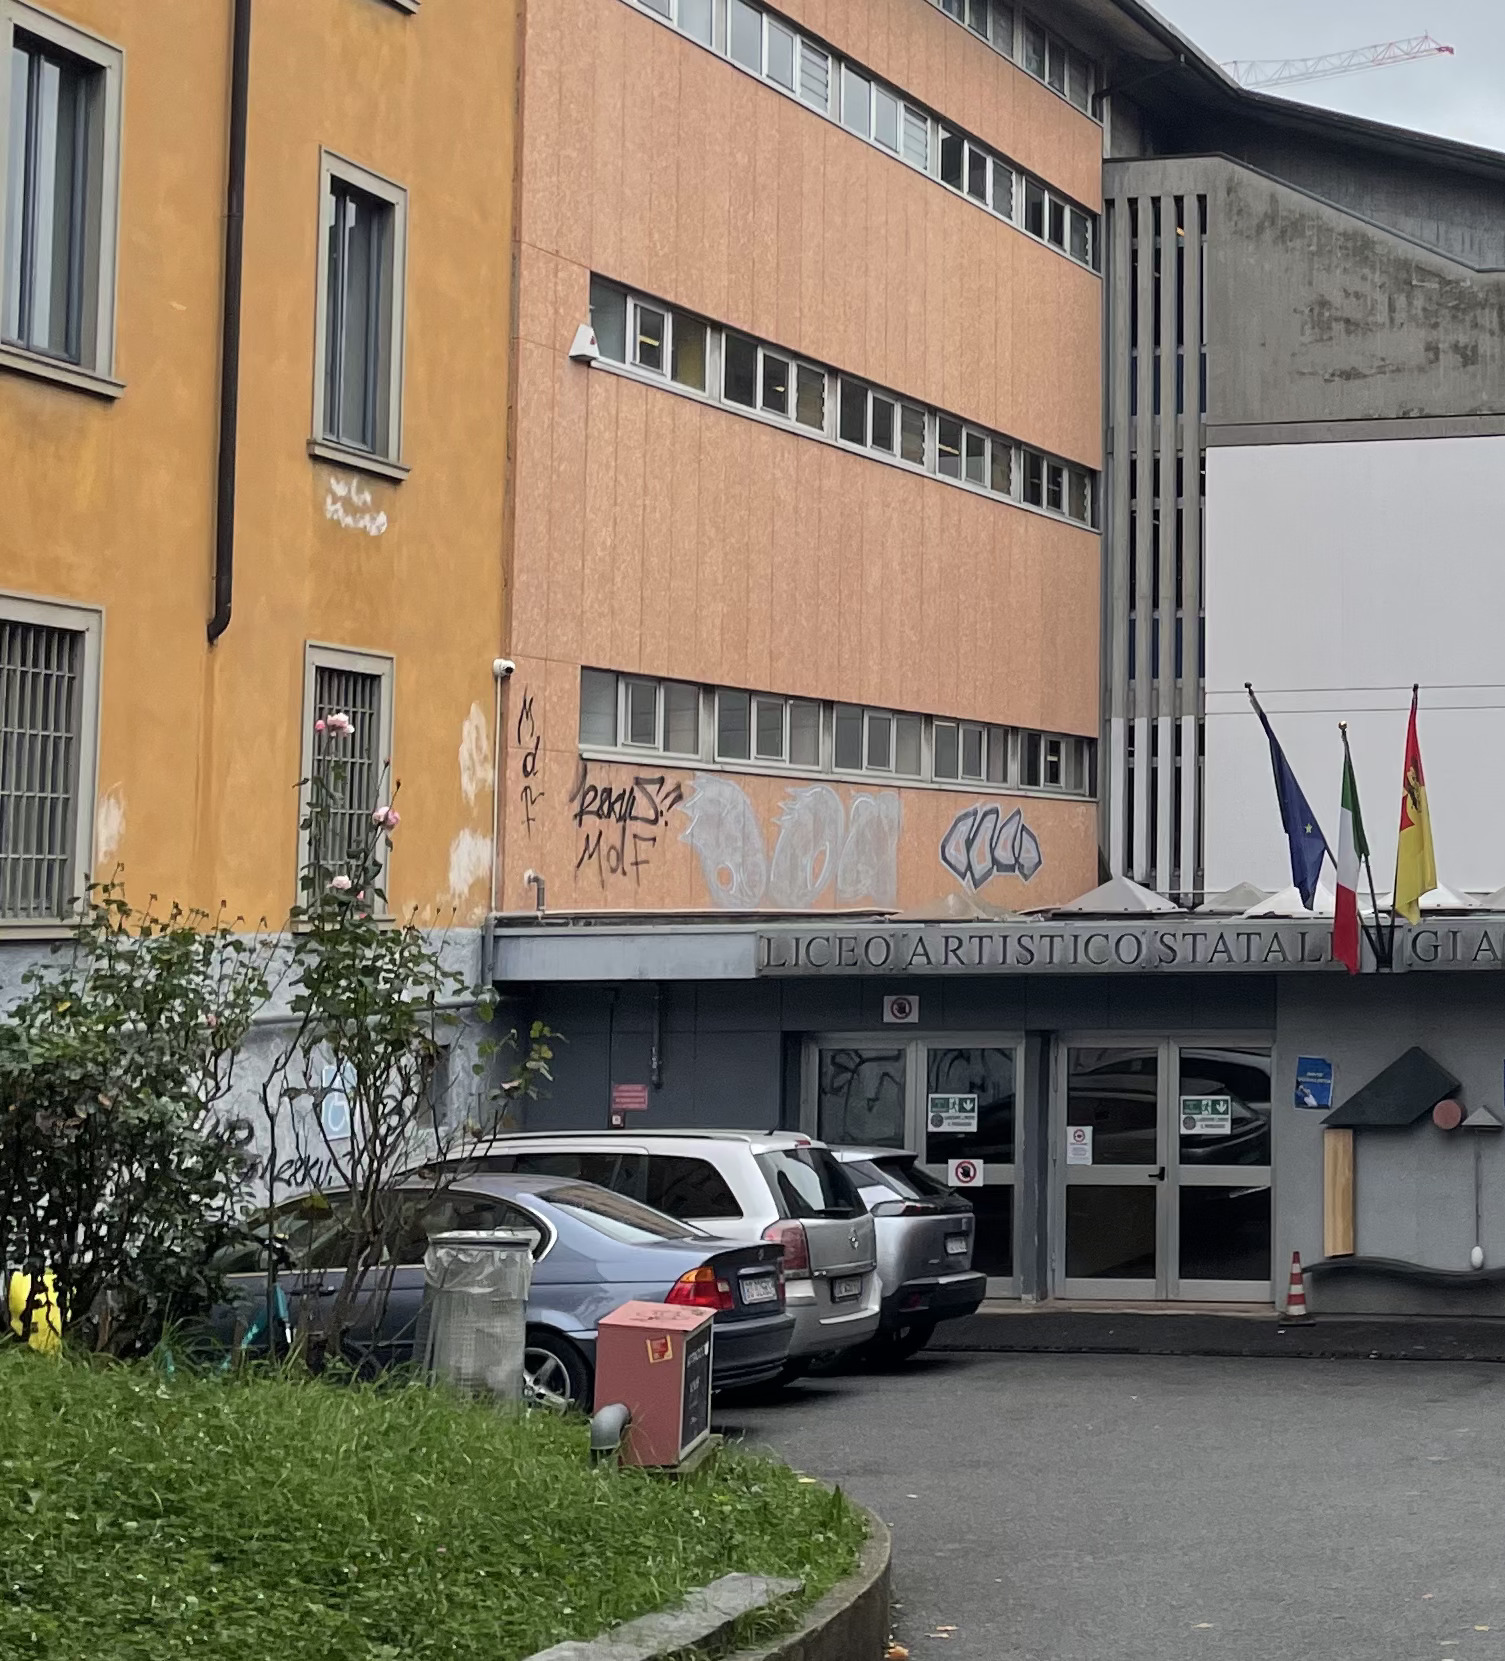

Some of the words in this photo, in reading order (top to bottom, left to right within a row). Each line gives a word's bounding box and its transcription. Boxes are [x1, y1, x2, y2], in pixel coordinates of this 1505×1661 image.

[764, 934, 892, 968] LICEO
[906, 932, 1145, 968] ARTISTICO
[1157, 930, 1335, 964] STATAL
